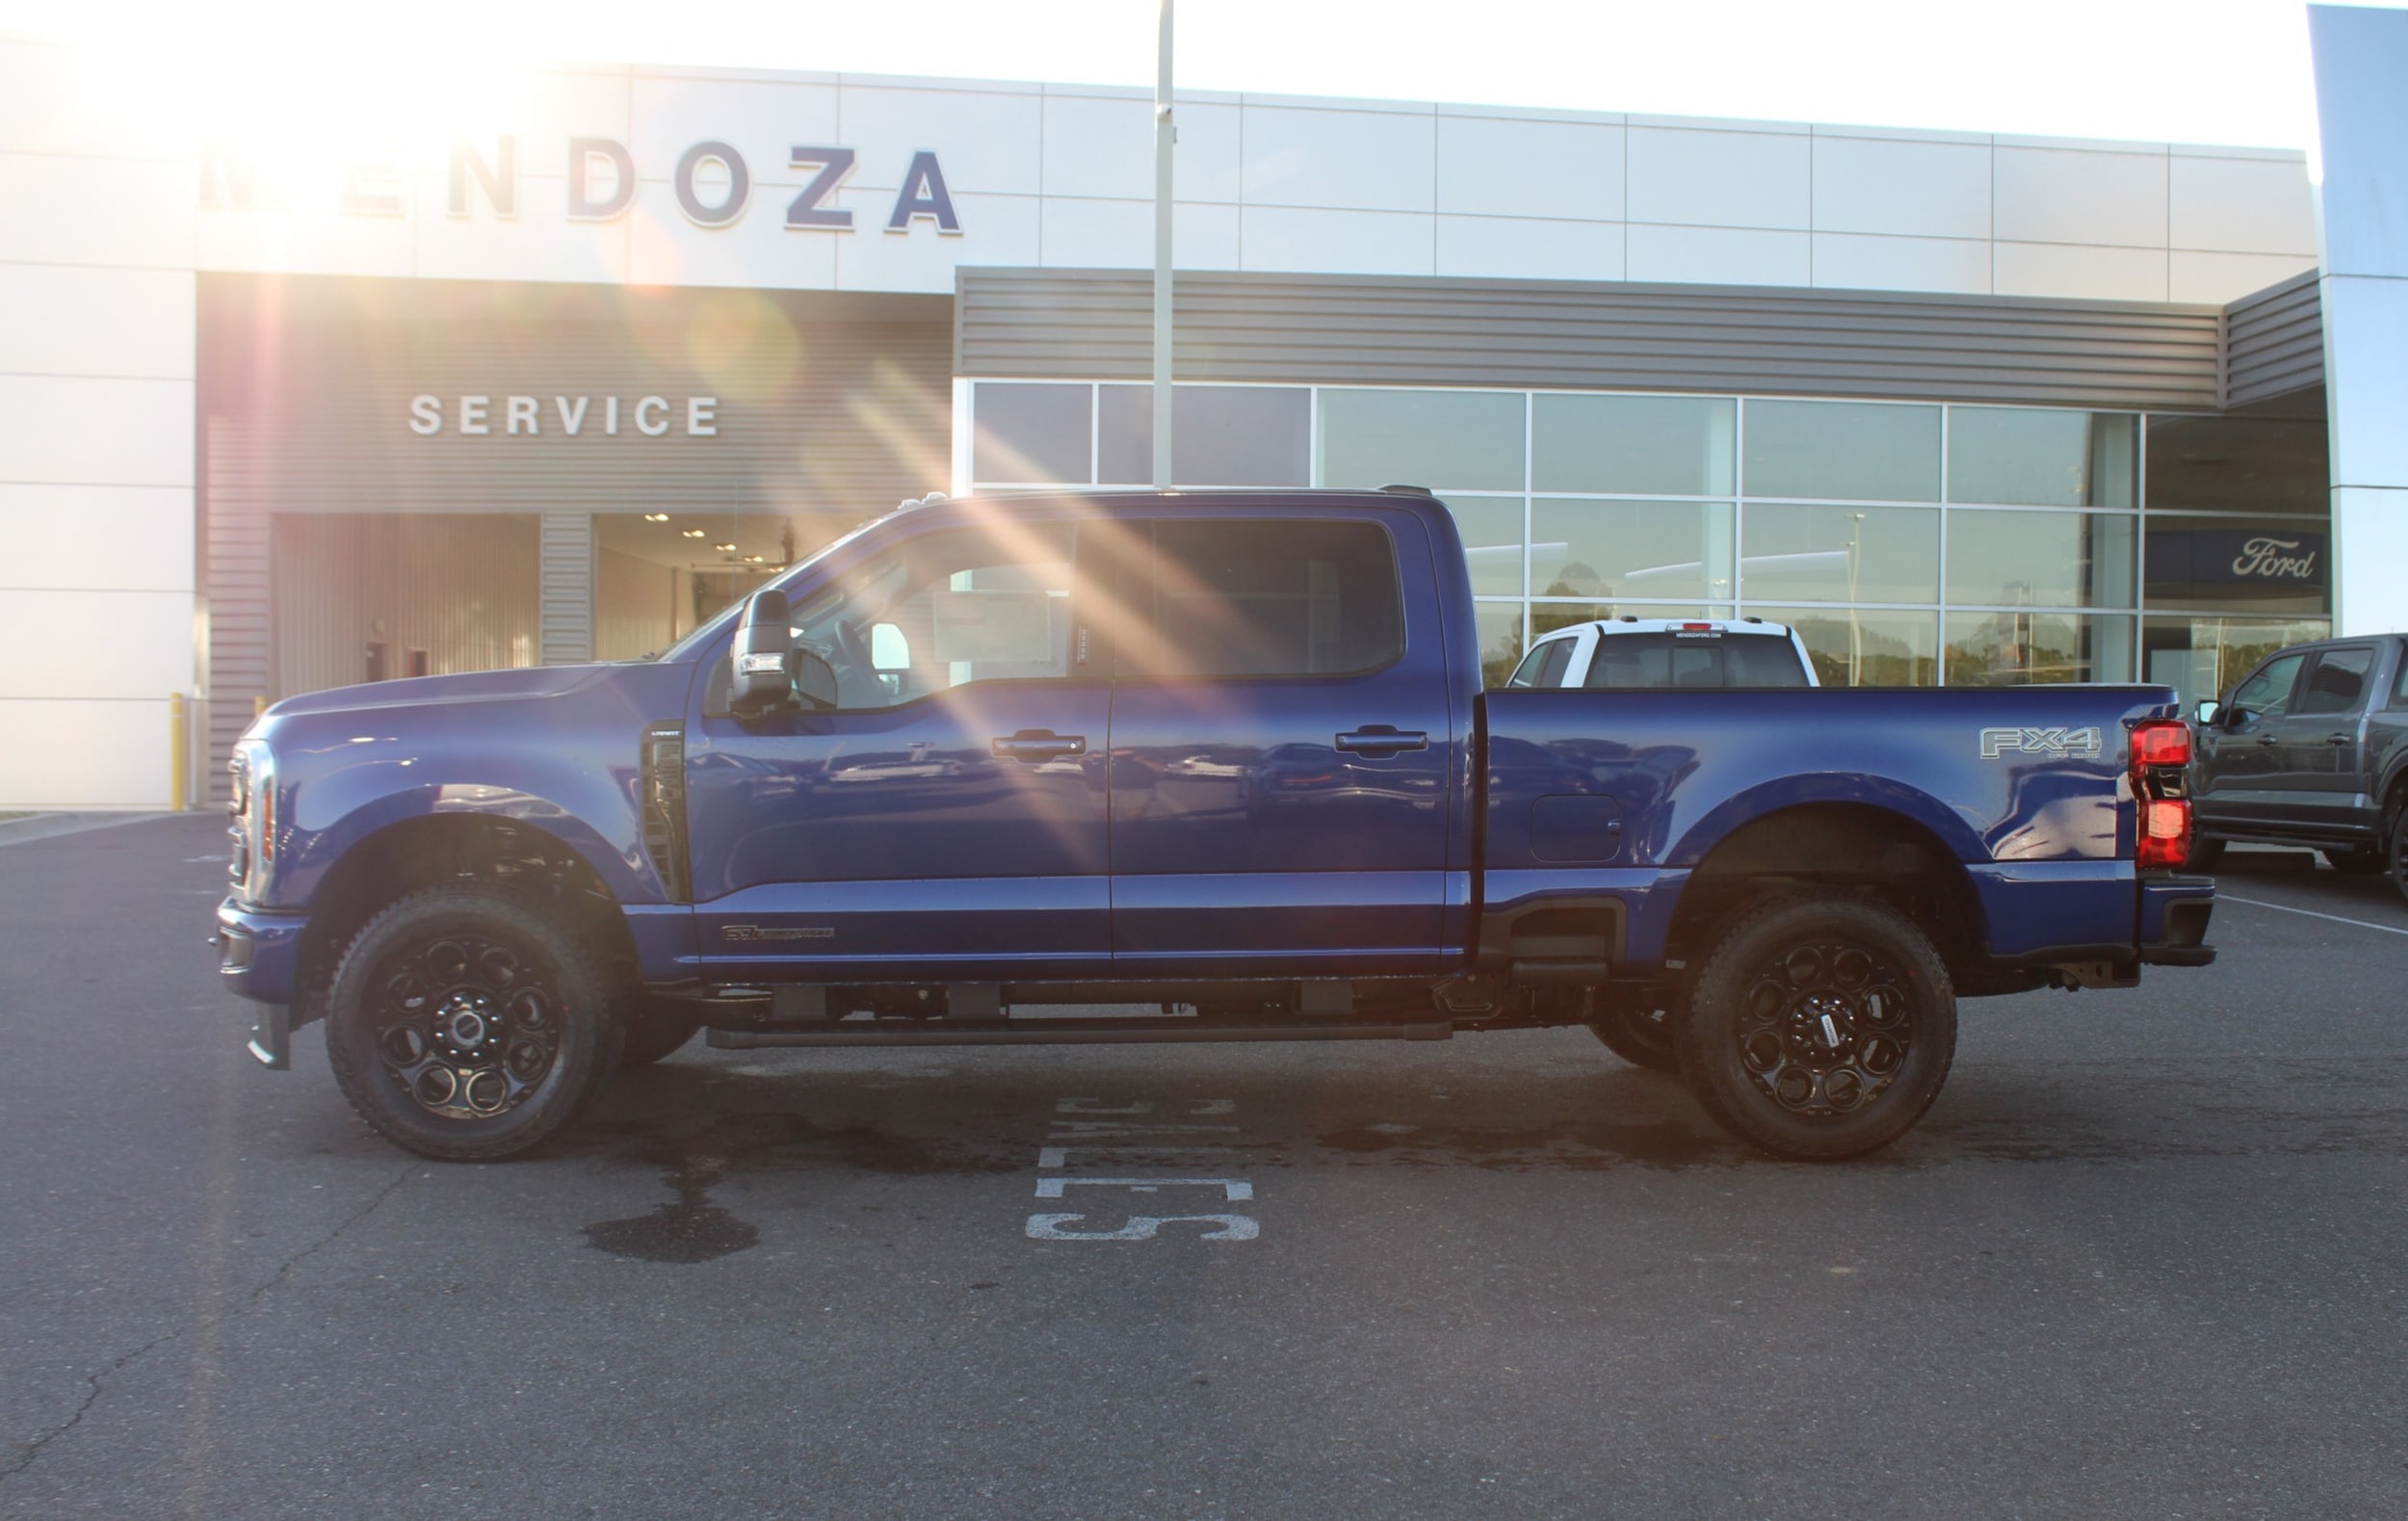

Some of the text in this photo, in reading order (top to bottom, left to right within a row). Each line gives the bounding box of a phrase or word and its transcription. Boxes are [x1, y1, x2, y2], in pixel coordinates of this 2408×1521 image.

[409, 395, 718, 435] SERVICE
[2232, 537, 2315, 579] Ford
[1980, 727, 2102, 759] FX4
